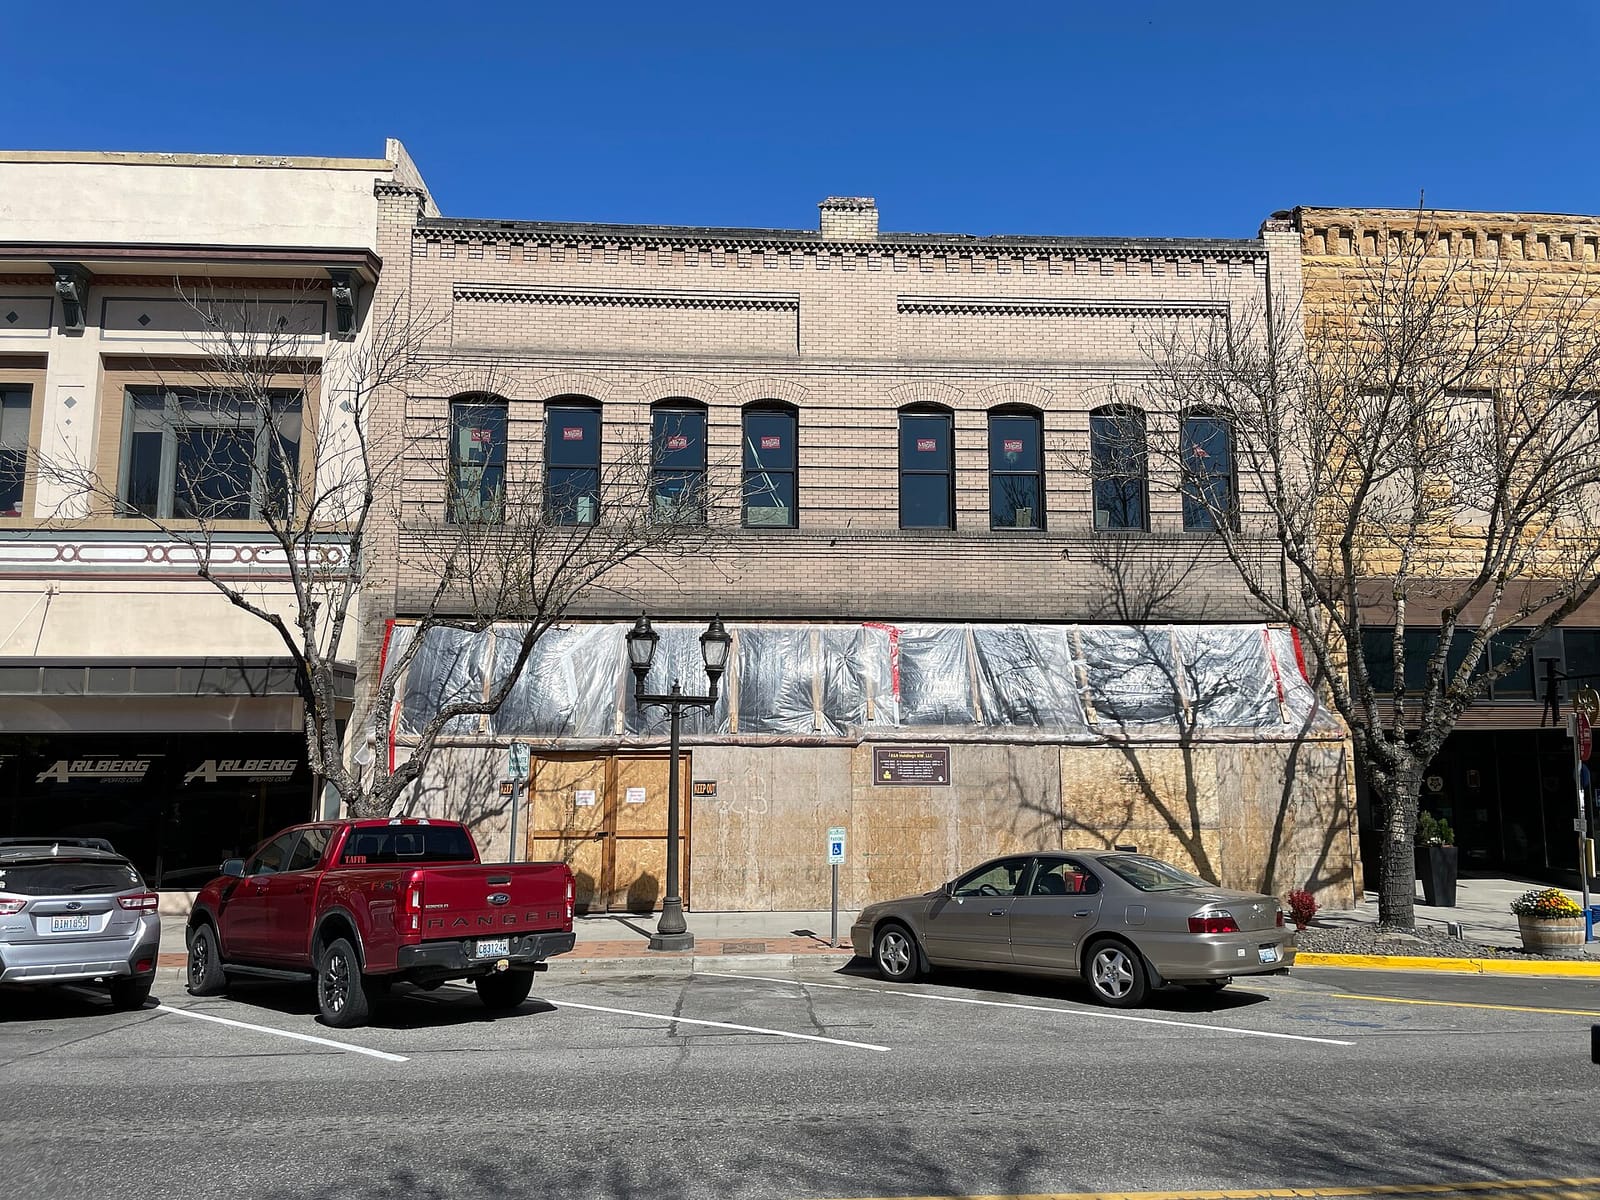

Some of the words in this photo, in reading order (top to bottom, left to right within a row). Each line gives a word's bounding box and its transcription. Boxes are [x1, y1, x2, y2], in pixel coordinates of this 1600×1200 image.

[35, 760, 151, 783] ARLBERG
[184, 760, 299, 783] ARLBERG
[694, 783, 706, 795] KEEP
[706, 783, 716, 795] OUT
[427, 911, 560, 929] RANGER
